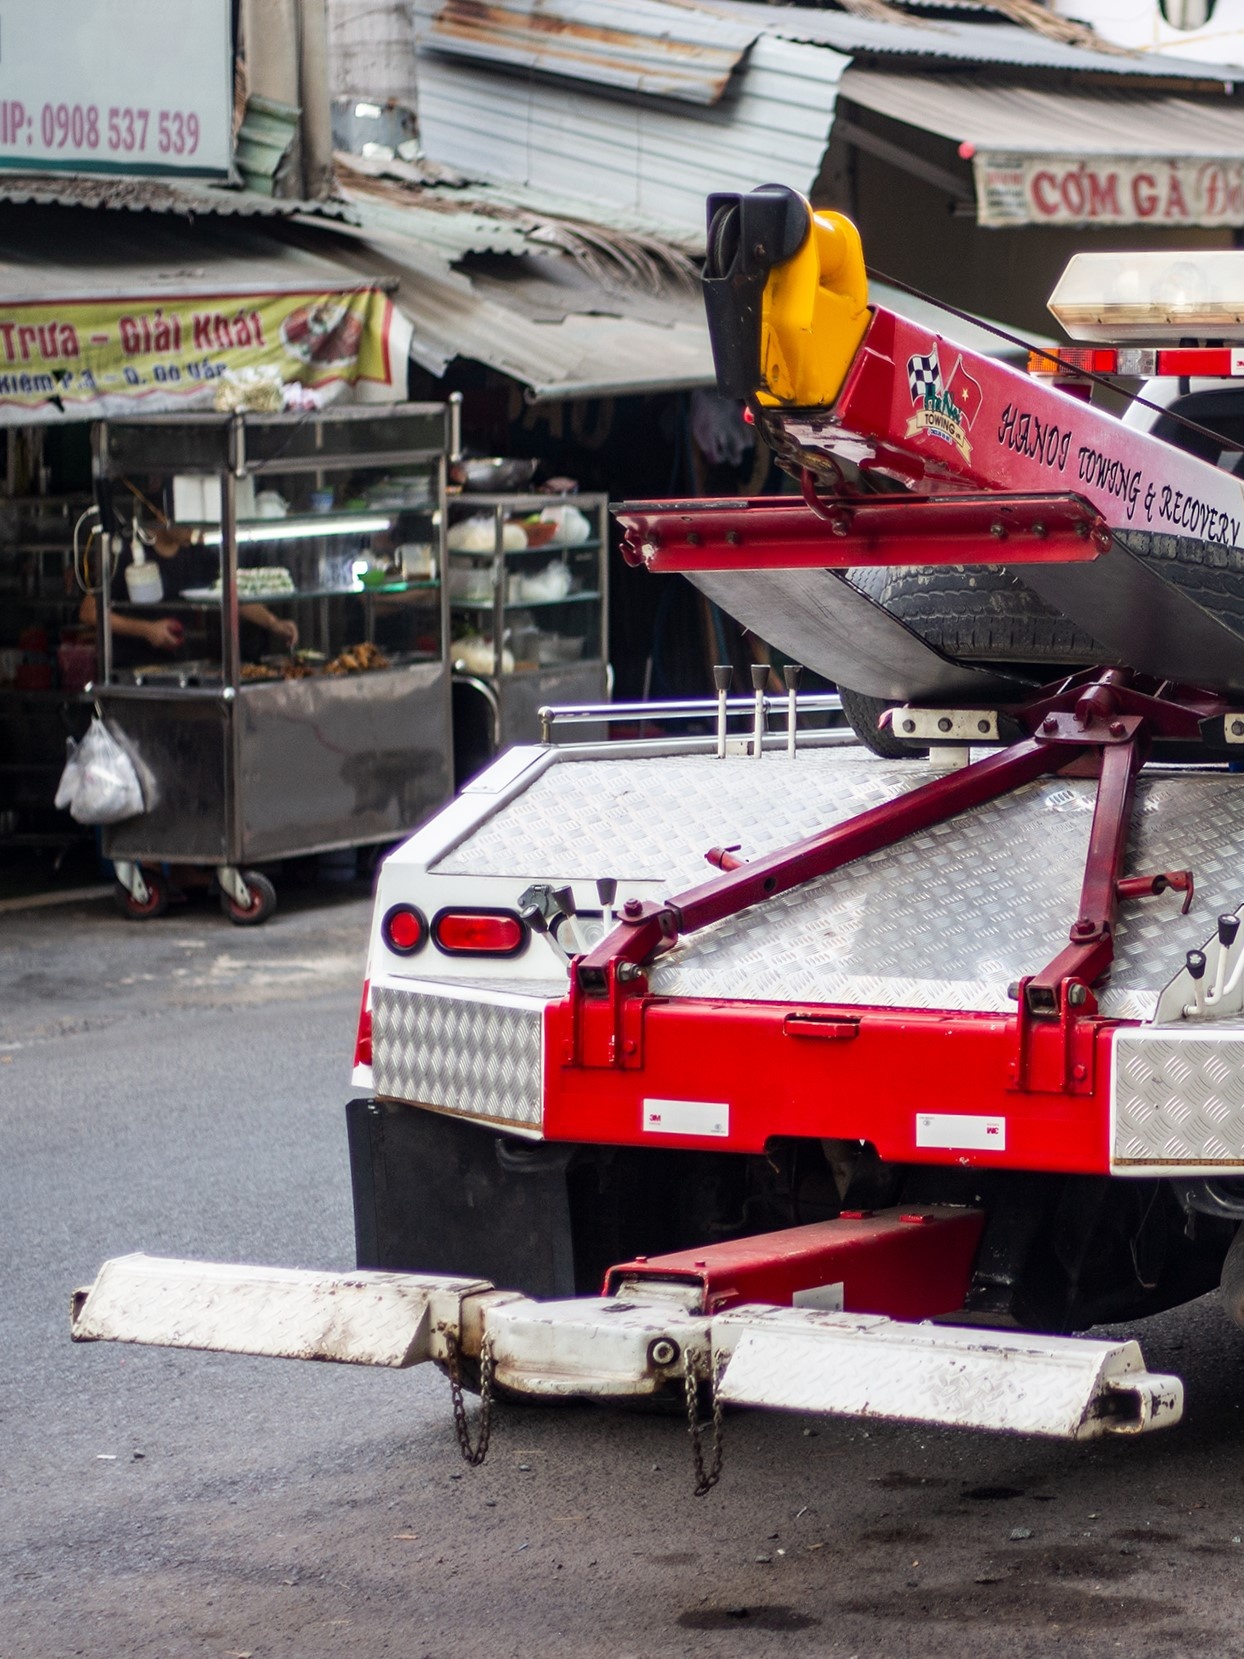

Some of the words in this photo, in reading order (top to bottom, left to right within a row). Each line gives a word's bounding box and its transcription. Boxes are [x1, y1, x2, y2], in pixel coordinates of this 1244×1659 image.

[41, 102, 100, 150] 0908
[108, 107, 150, 151] 537
[158, 110, 200, 155] 539
[1030, 161, 1122, 217] CƠM
[1130, 159, 1191, 218] GÀ
[0, 321, 80, 361] Trưa
[119, 308, 182, 357] Giải
[192, 308, 266, 350] Khát
[924, 413, 956, 435] TOWING
[997, 402, 1073, 472] HANOI
[1077, 446, 1143, 521] TOWING
[1144, 482, 1157, 522] &
[1159, 484, 1241, 546] RECOVERY
[648, 1113, 662, 1123] 3M
[986, 1126, 1000, 1135] 3M
